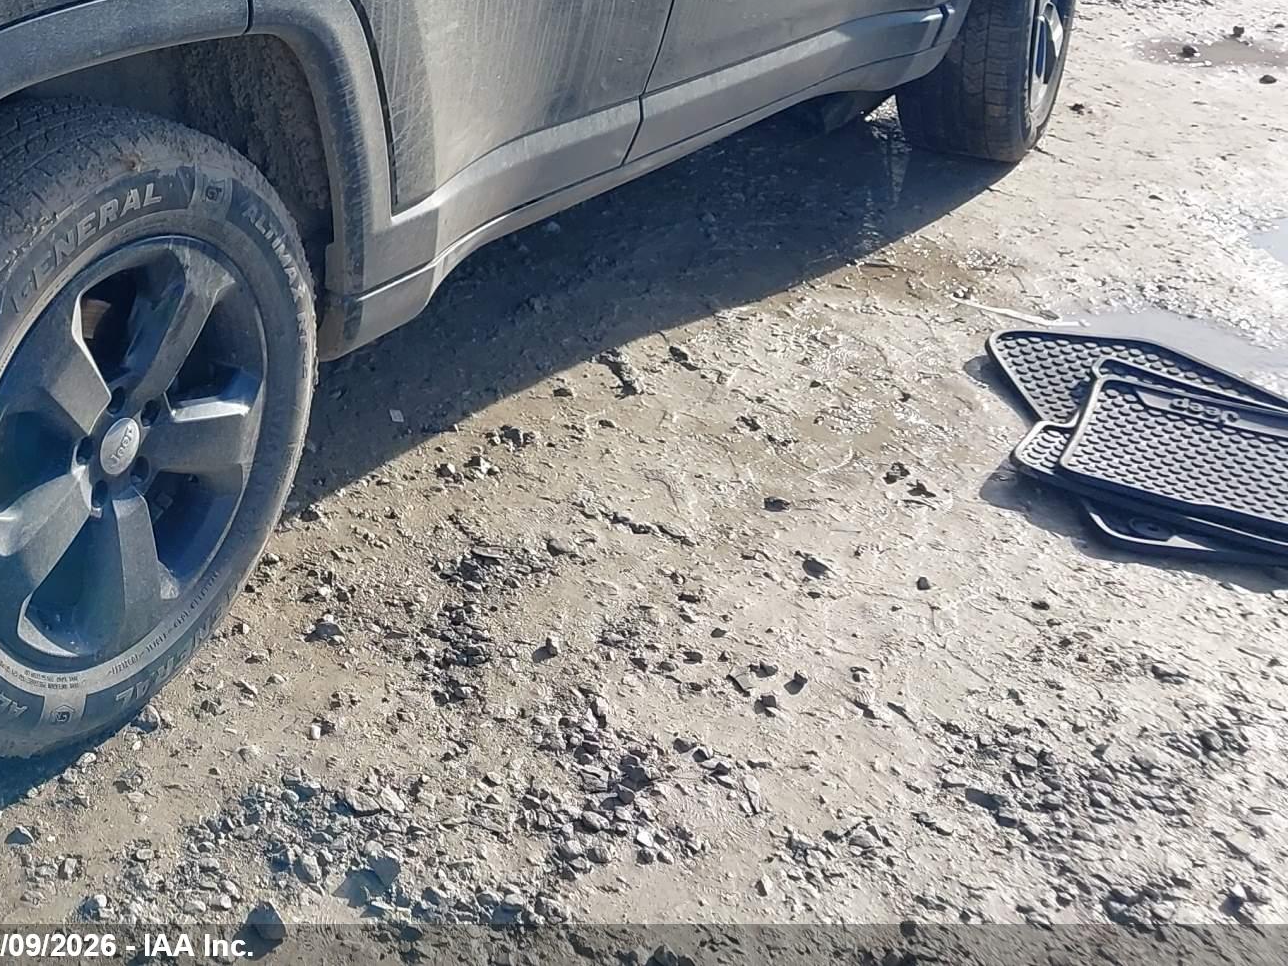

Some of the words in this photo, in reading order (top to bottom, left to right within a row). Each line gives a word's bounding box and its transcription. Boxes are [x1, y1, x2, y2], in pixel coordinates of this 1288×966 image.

[10, 181, 163, 313] GENERAL
[240, 201, 307, 302] ALTIMAX
[110, 424, 133, 467] Jeep
